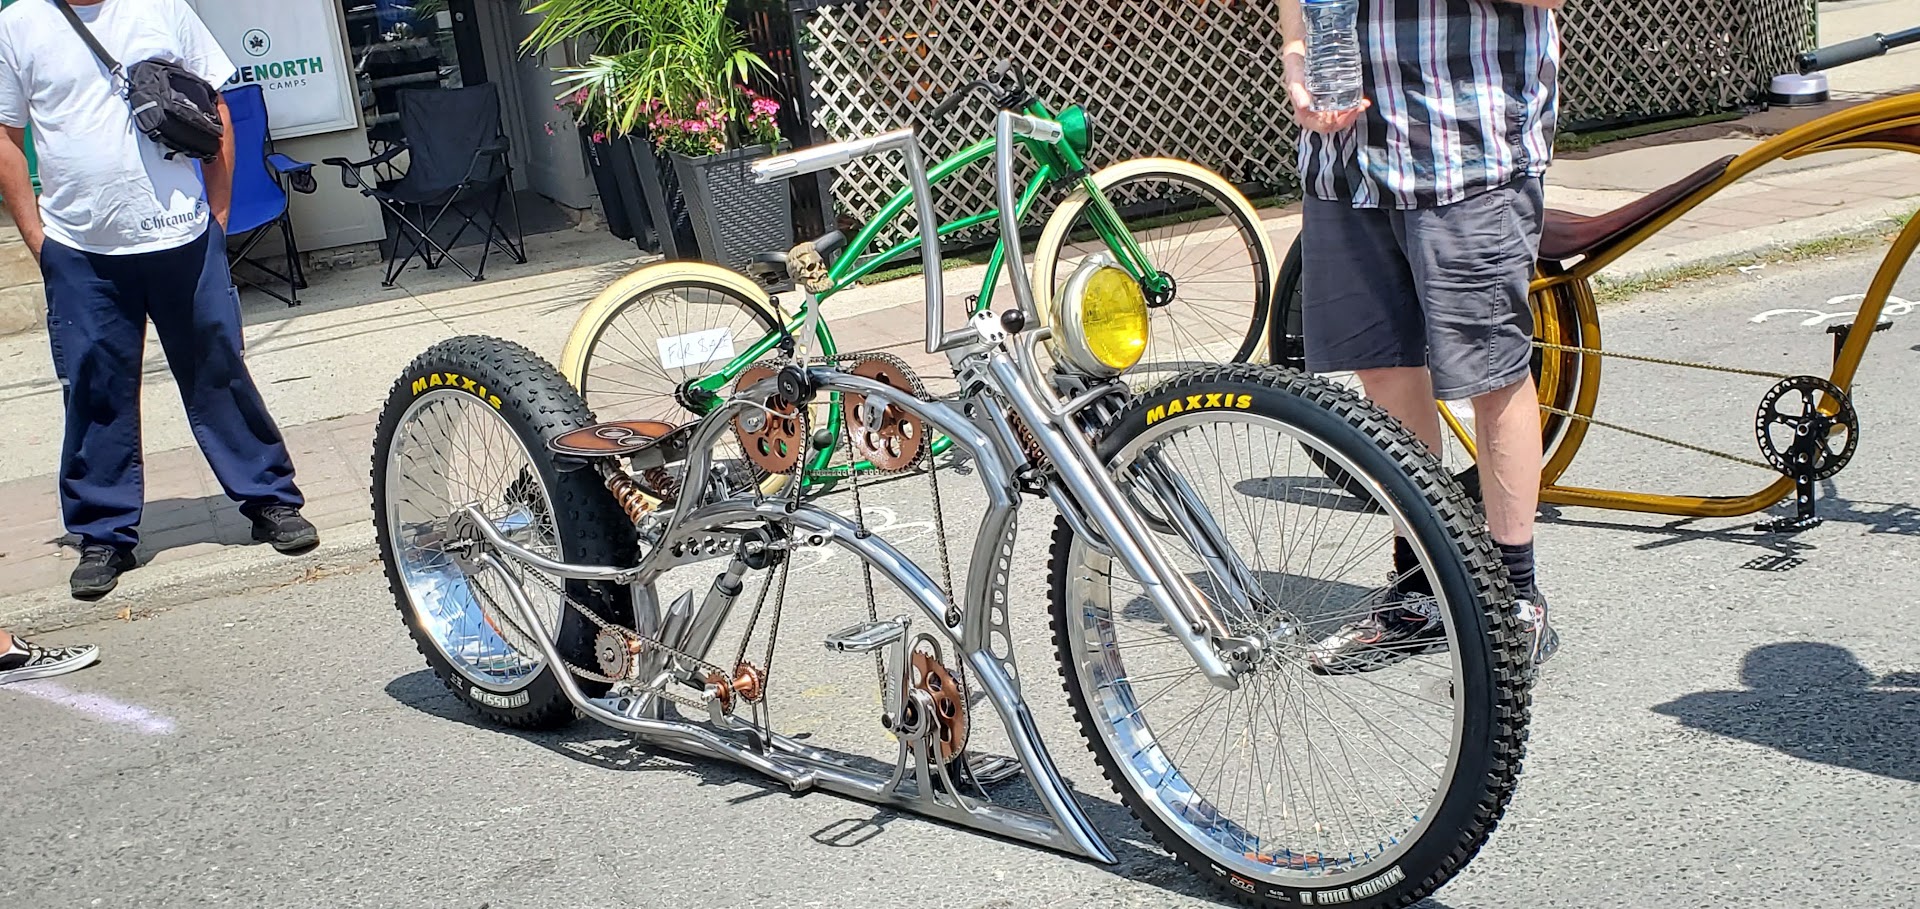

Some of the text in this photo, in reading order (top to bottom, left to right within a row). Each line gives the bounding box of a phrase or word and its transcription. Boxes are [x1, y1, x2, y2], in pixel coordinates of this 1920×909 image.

[223, 57, 324, 85] UENORTH
[269, 79, 307, 90] CAMPS
[412, 372, 502, 410] MAXXIS
[1146, 393, 1252, 425] MAXXIS
[1351, 865, 1406, 900] MINION
